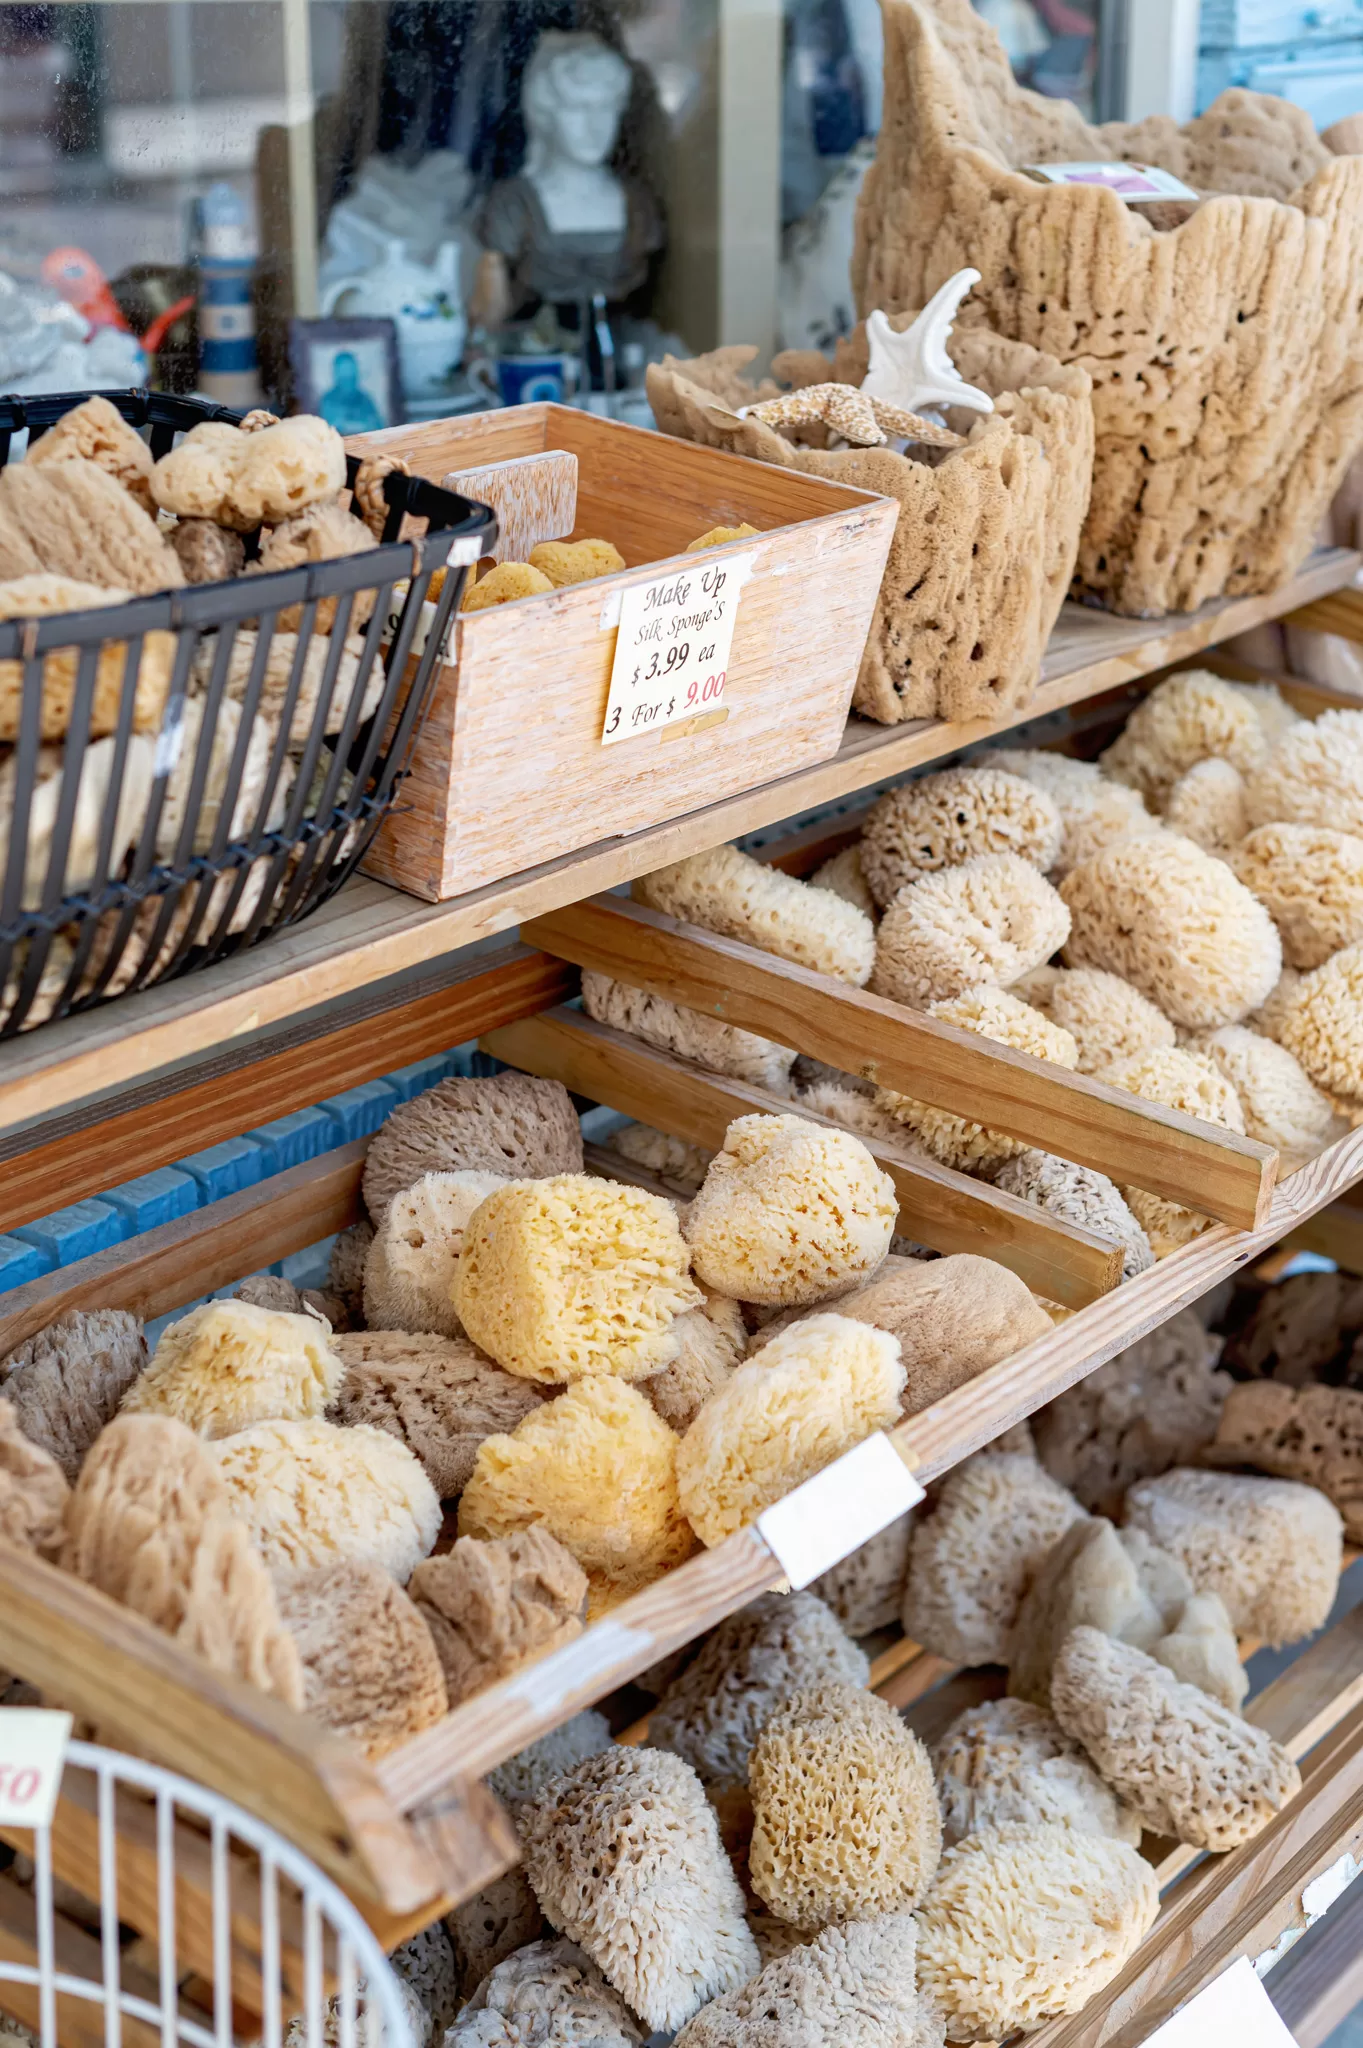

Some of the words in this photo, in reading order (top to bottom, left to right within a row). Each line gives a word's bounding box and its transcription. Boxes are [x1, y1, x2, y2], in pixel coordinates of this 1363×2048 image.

[644, 575, 691, 612] Make
[701, 566, 727, 598] Up
[634, 617, 663, 645] Silk
[698, 643, 715, 662] ea
[606, 706, 622, 734] 3
[631, 702, 662, 727] For
